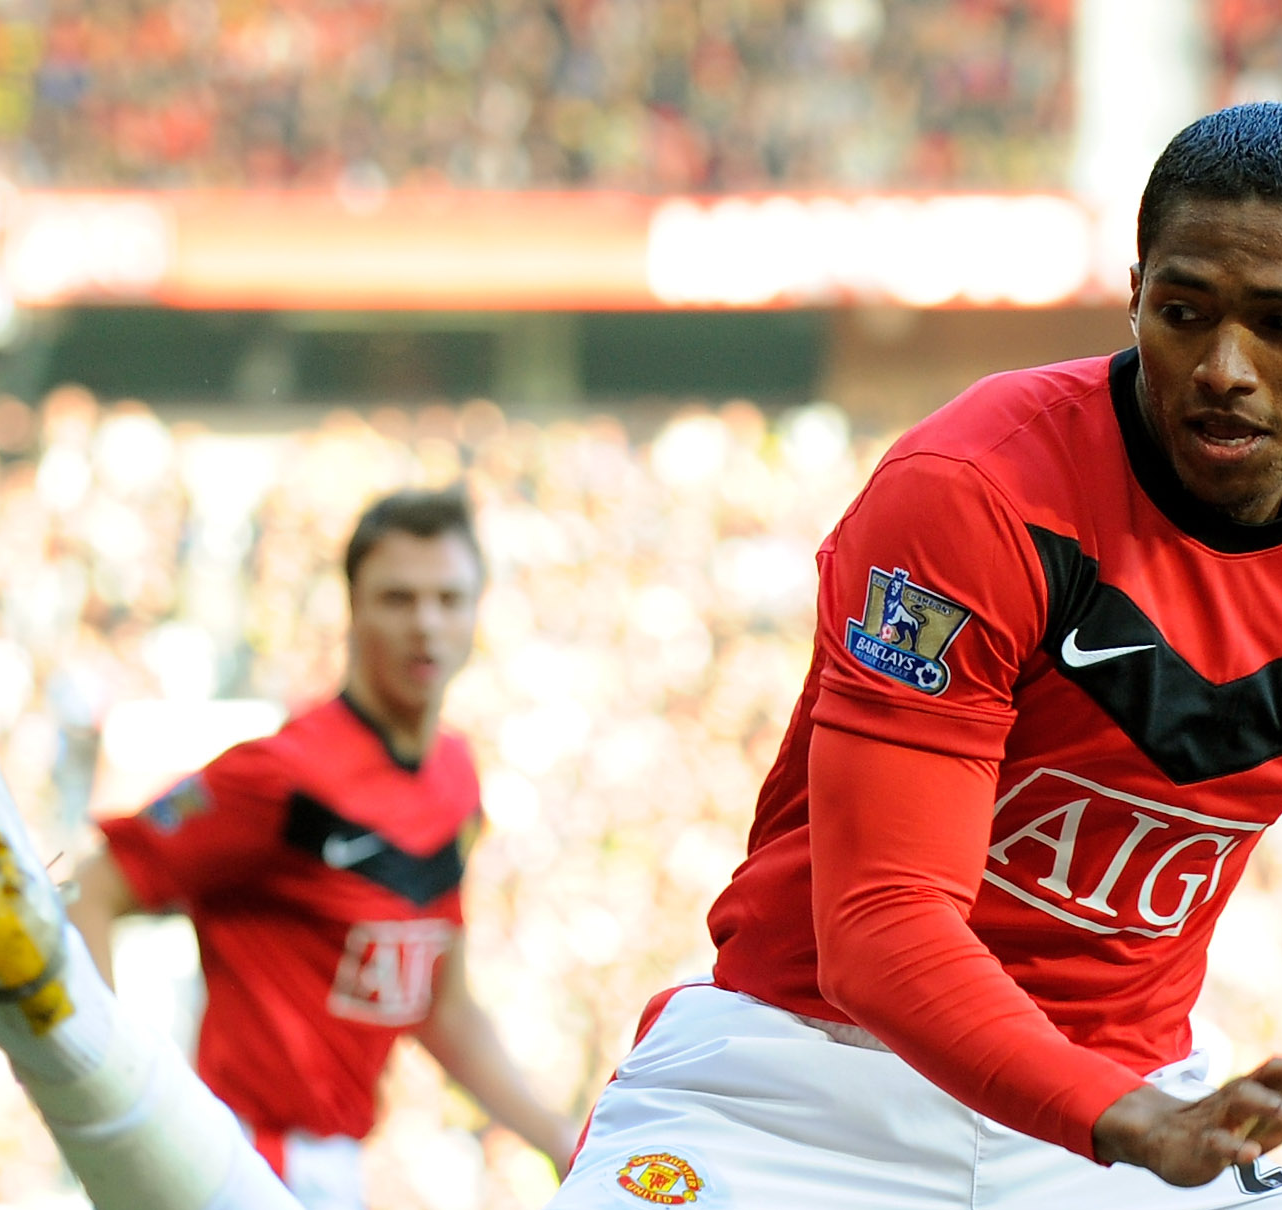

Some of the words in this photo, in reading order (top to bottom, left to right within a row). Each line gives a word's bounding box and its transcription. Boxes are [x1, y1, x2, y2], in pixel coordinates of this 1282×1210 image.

[856, 636, 915, 670] BARCLAYS
[877, 660, 909, 679] LEAGUE
[988, 798, 1234, 926] AIG
[625, 1182, 673, 1204] UNITED
